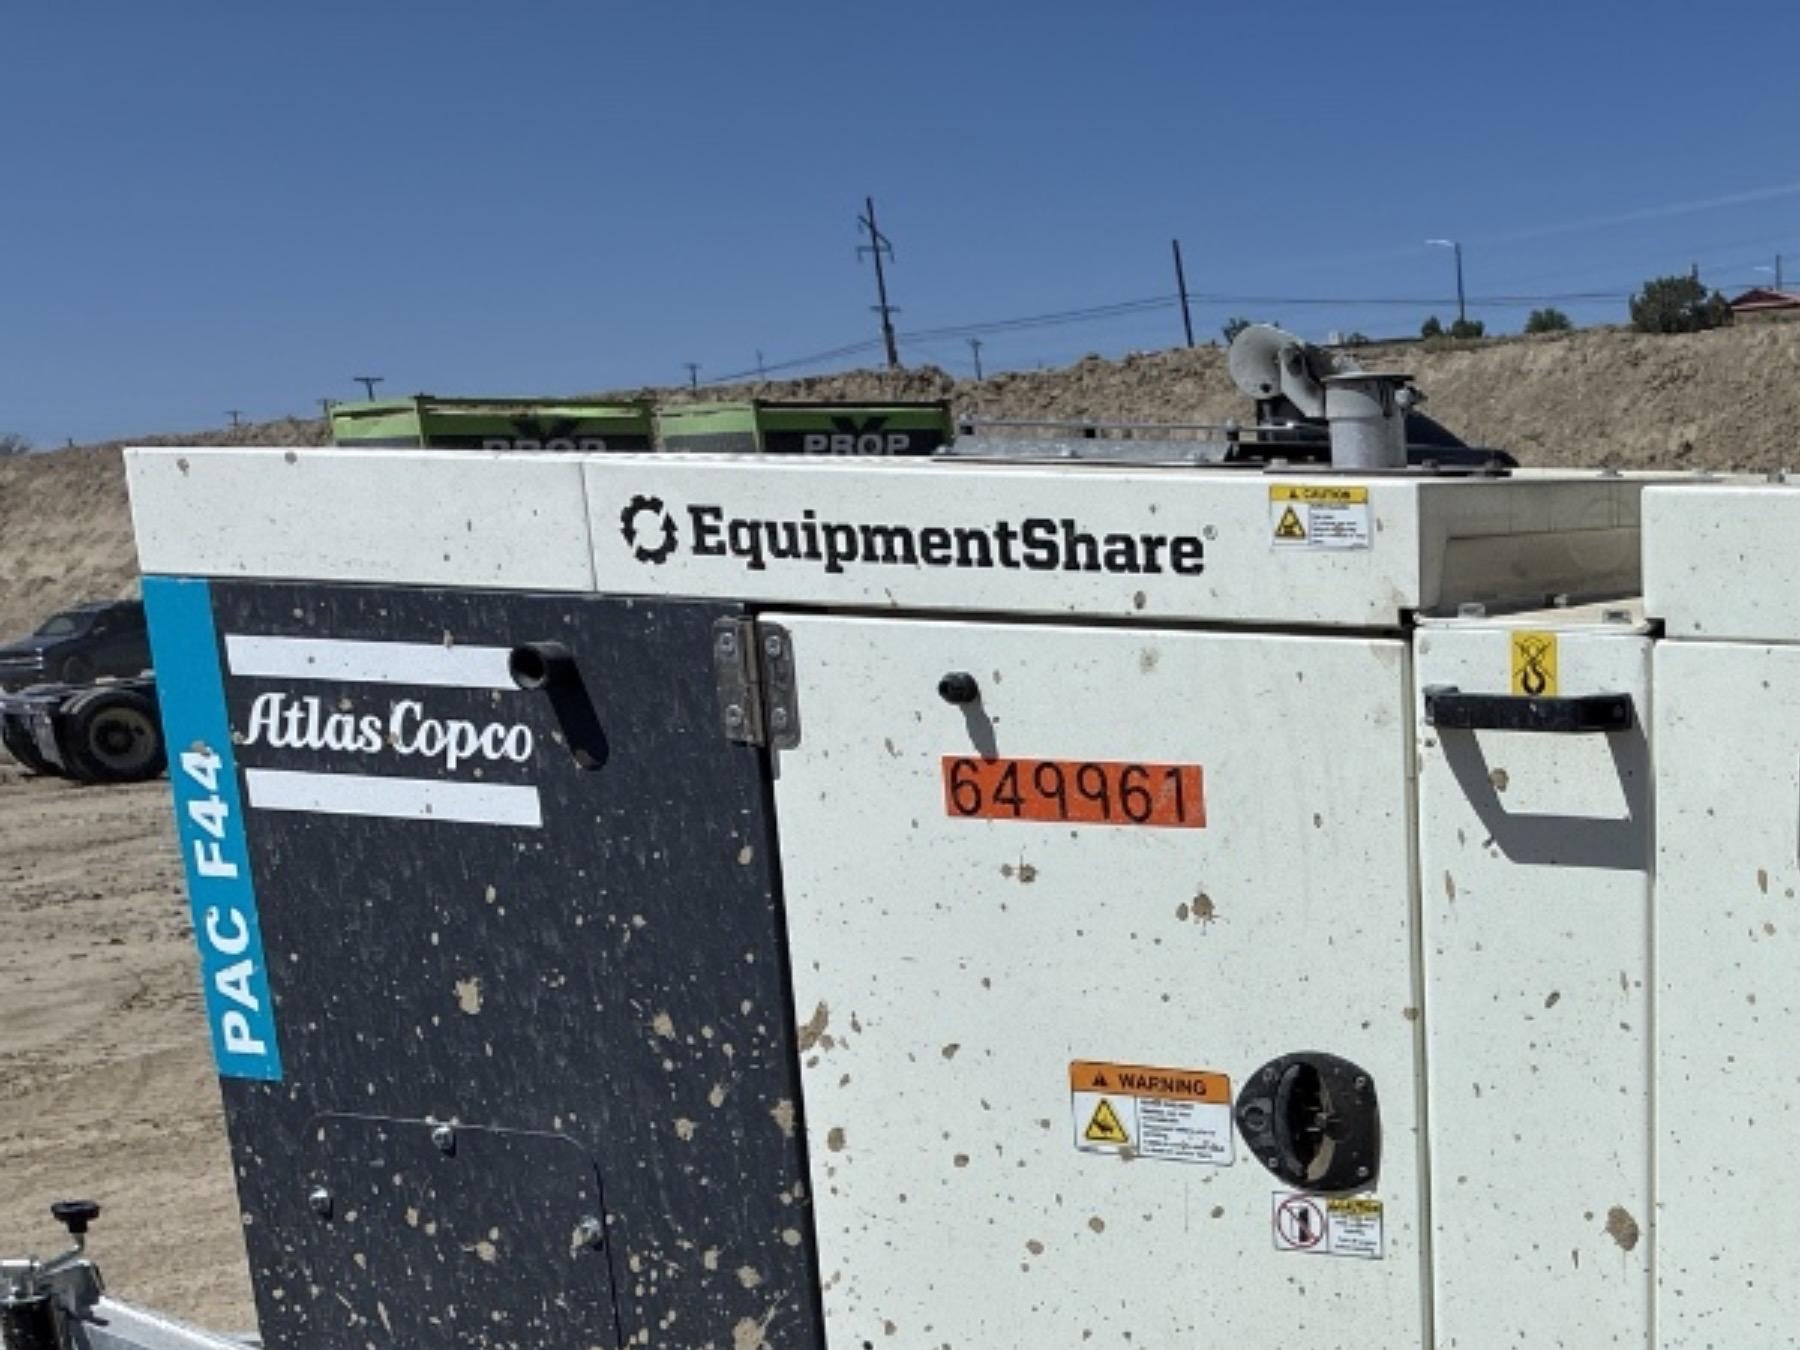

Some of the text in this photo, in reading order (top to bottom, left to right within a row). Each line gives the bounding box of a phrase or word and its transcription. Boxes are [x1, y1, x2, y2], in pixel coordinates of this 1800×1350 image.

[687, 504, 1205, 574] EquipmentShare
[242, 692, 534, 769] Atlas Copco
[949, 759, 1187, 824] 649961
[180, 748, 267, 1056] PAC F44
[1117, 1072, 1207, 1097] WARNING
